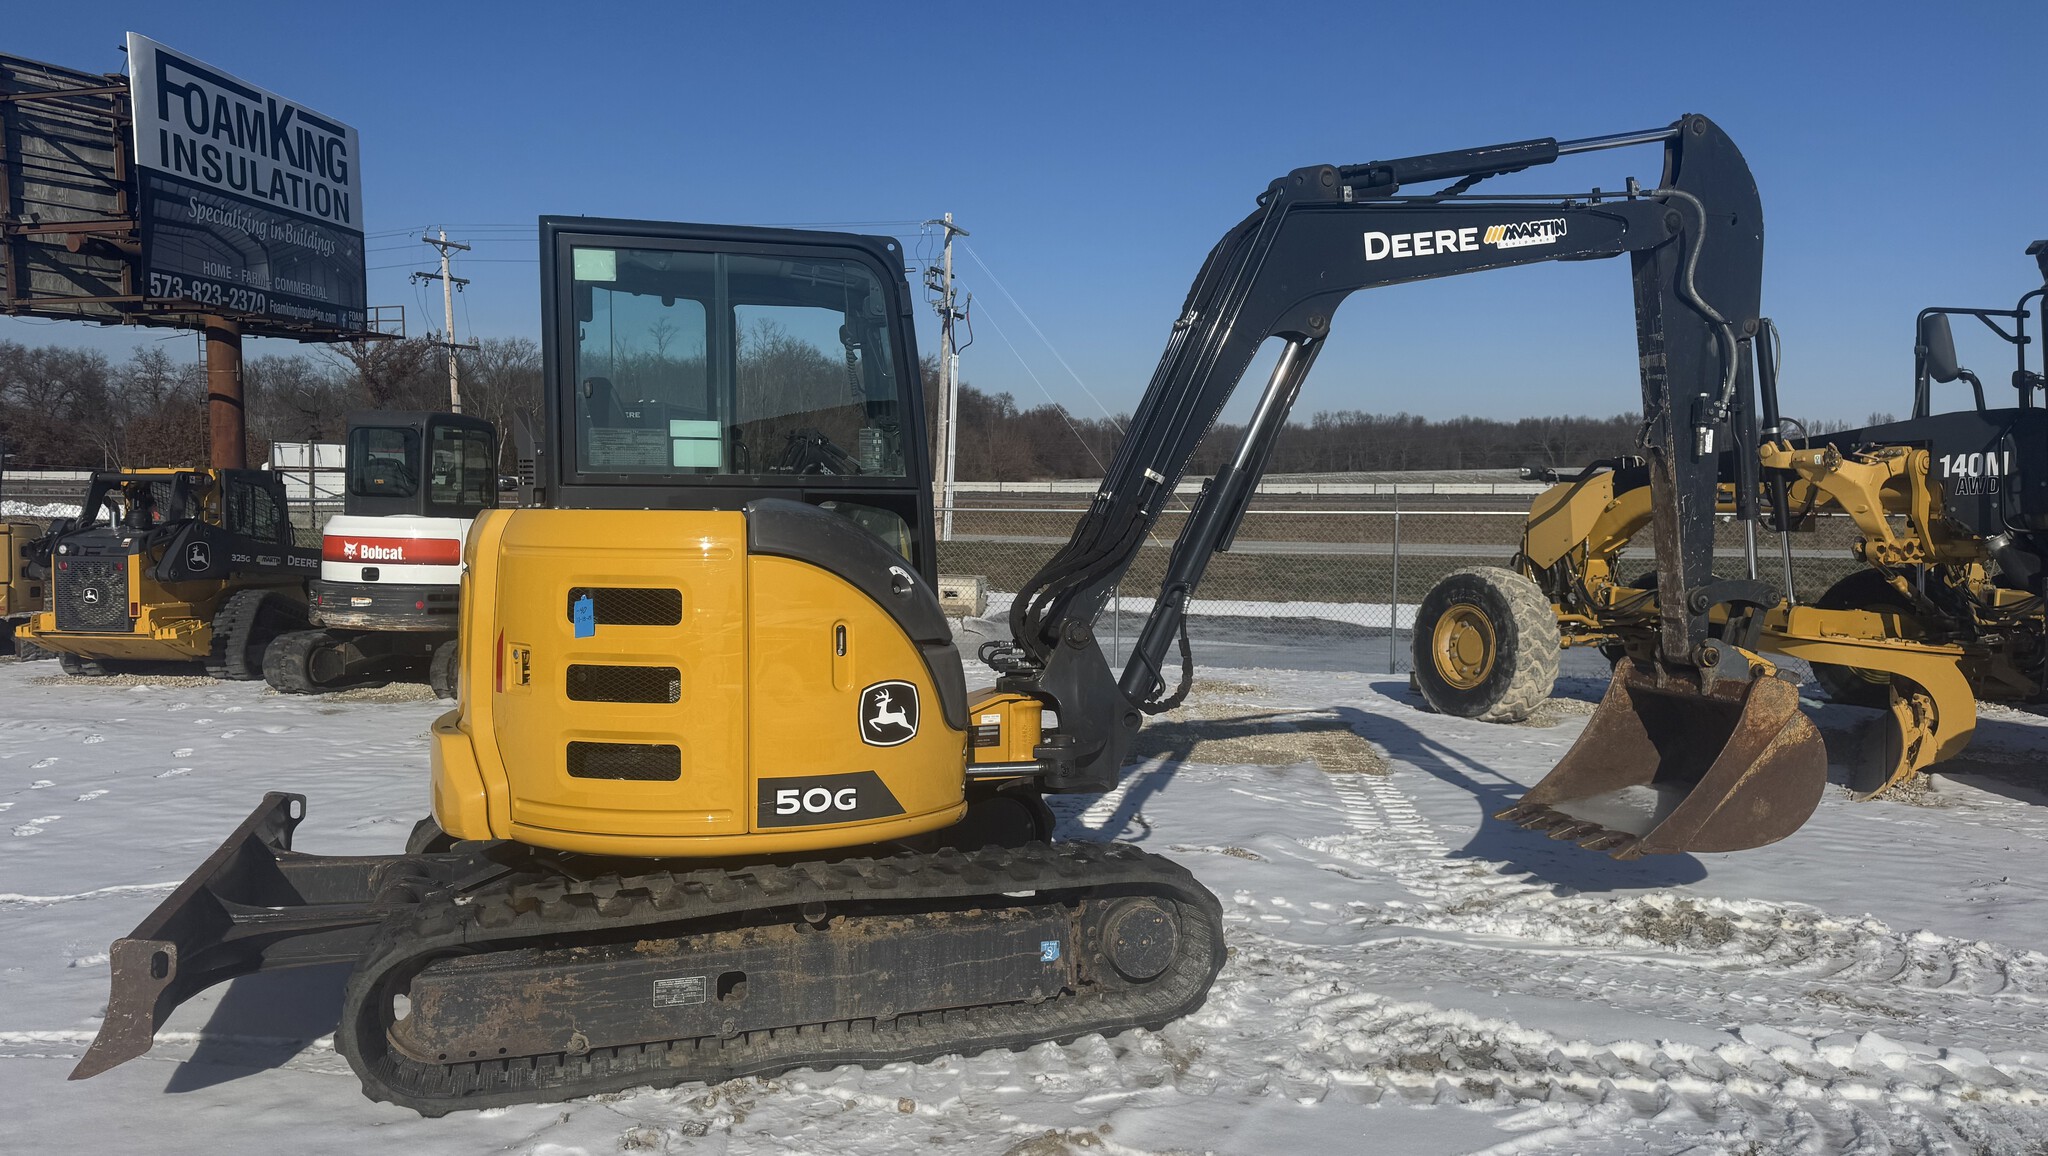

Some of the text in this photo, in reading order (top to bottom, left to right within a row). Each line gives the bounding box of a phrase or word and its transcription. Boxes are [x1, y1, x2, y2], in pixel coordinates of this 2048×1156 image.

[160, 128, 350, 224] INSULATION
[188, 196, 336, 257] Specializing in Buildings
[1363, 219, 1566, 261] DEERE MARTIN
[150, 272, 266, 315] 573-823-2370
[203, 261, 232, 279] HOME
[241, 269, 266, 287] FARM
[275, 277, 328, 300] COMMERCIAL
[1940, 451, 2010, 478] 140M
[1955, 475, 2000, 496] AWD
[231, 553, 251, 563] 325G
[287, 555, 318, 568] DEERE
[360, 545, 403, 560] Bobcat
[776, 787, 857, 815] 50G
